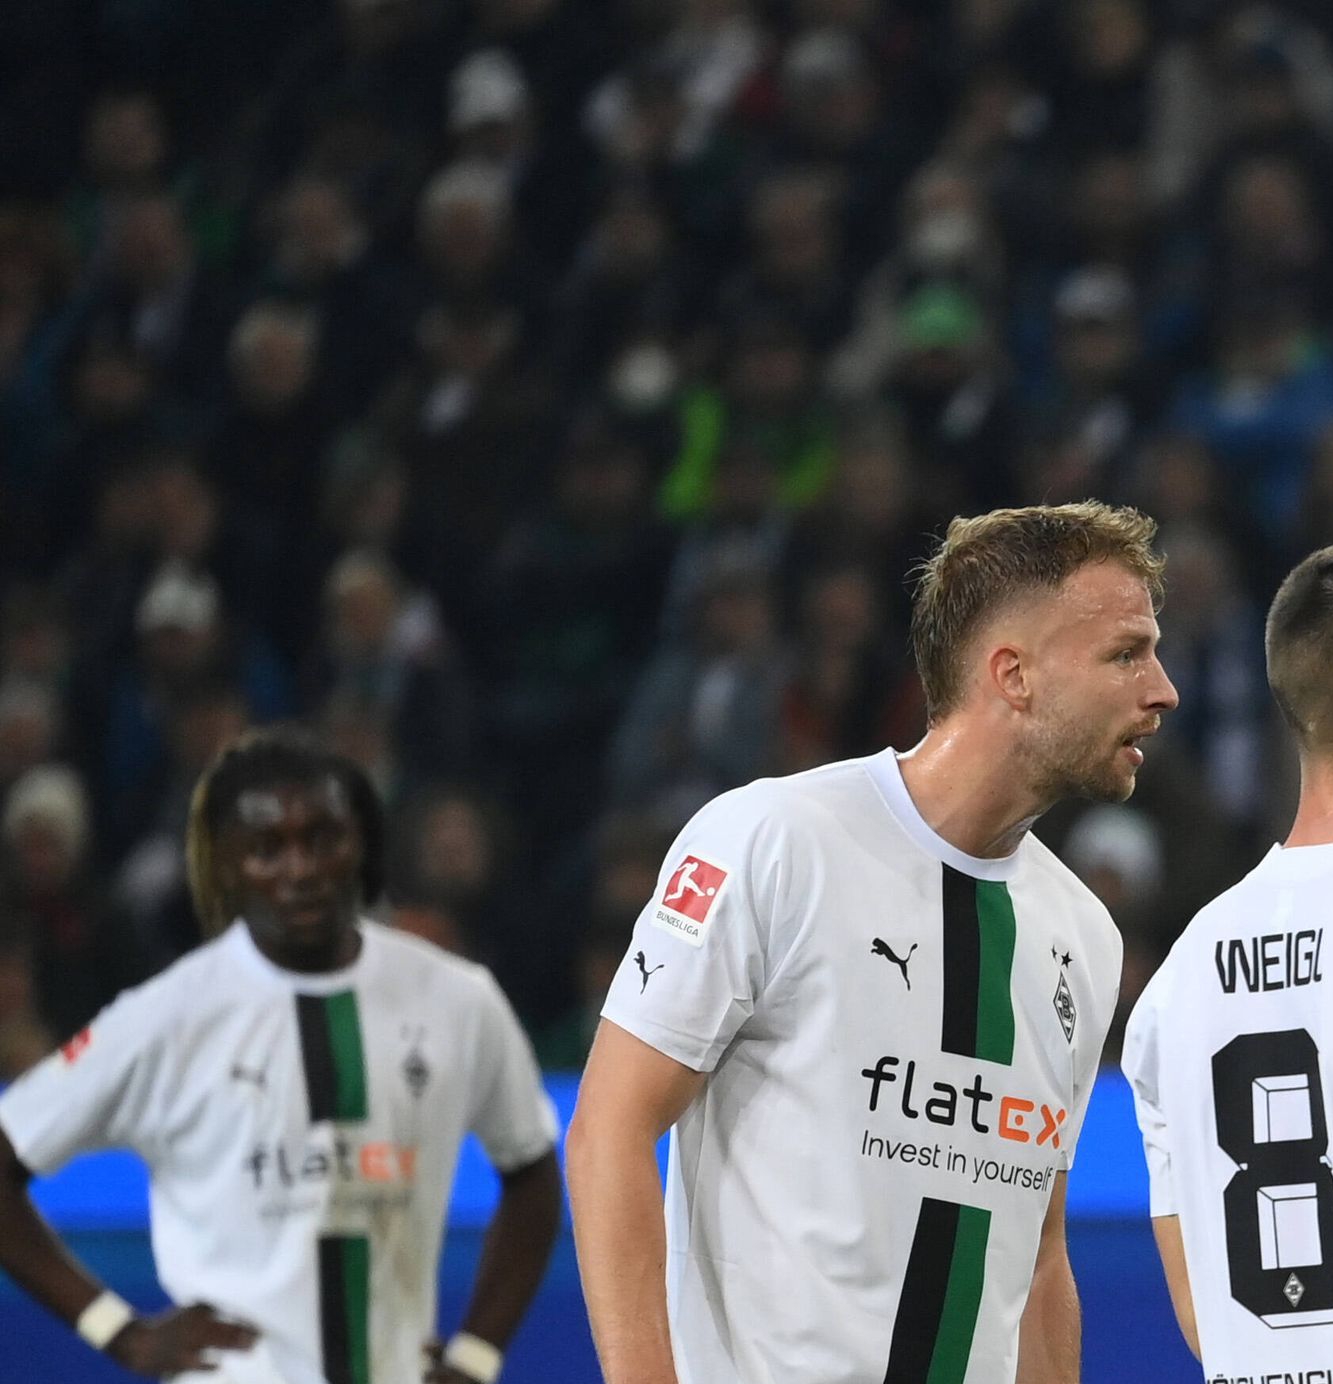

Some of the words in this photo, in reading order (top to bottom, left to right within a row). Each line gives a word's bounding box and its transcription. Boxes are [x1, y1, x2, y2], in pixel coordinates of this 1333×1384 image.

[1215, 928, 1323, 994] WEIGL
[861, 1129, 941, 1169] Invest
[946, 1144, 967, 1175] in
[972, 1156, 1054, 1192] yourself
